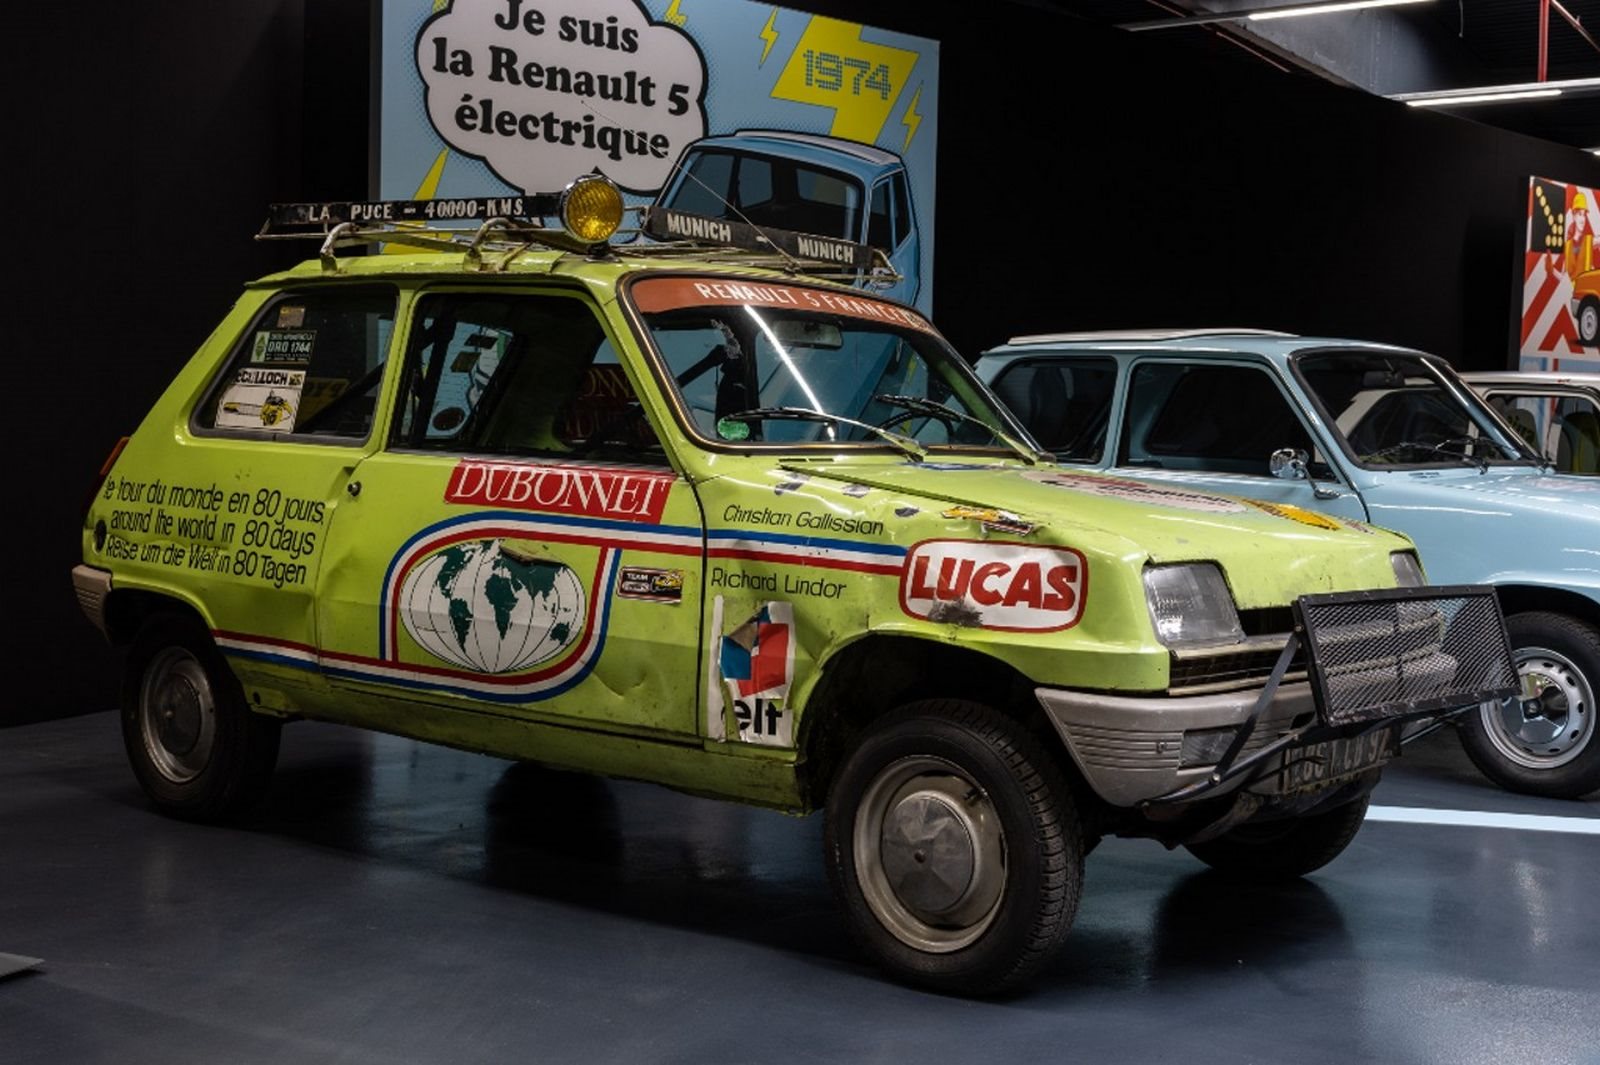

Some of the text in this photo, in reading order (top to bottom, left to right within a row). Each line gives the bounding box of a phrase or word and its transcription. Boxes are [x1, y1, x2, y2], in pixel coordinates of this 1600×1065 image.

[495, 0, 639, 54] Je suis
[432, 37, 690, 116] la Renault 5
[801, 48, 893, 100] 1974
[454, 93, 670, 161] électrique
[308, 205, 331, 222] LA
[351, 203, 393, 220] PUCE
[667, 213, 732, 242] MUNICH
[797, 236, 854, 264] MUNICH
[694, 282, 799, 306] RENAULT
[800, 292, 822, 308] 5
[117, 476, 147, 502] tour
[147, 479, 167, 505] du
[168, 483, 224, 512] monde
[228, 492, 250, 514] en
[253, 488, 281, 518] 80
[451, 463, 667, 517] DUBONNET
[110, 508, 316, 560] around the world in 80 days
[723, 504, 884, 537] Christian Gallissian
[106, 535, 307, 589] Reise um die Welt in 80 Tagen
[711, 568, 777, 593] Richard
[784, 574, 847, 600] Lindor
[909, 555, 1078, 612] LUCAS
